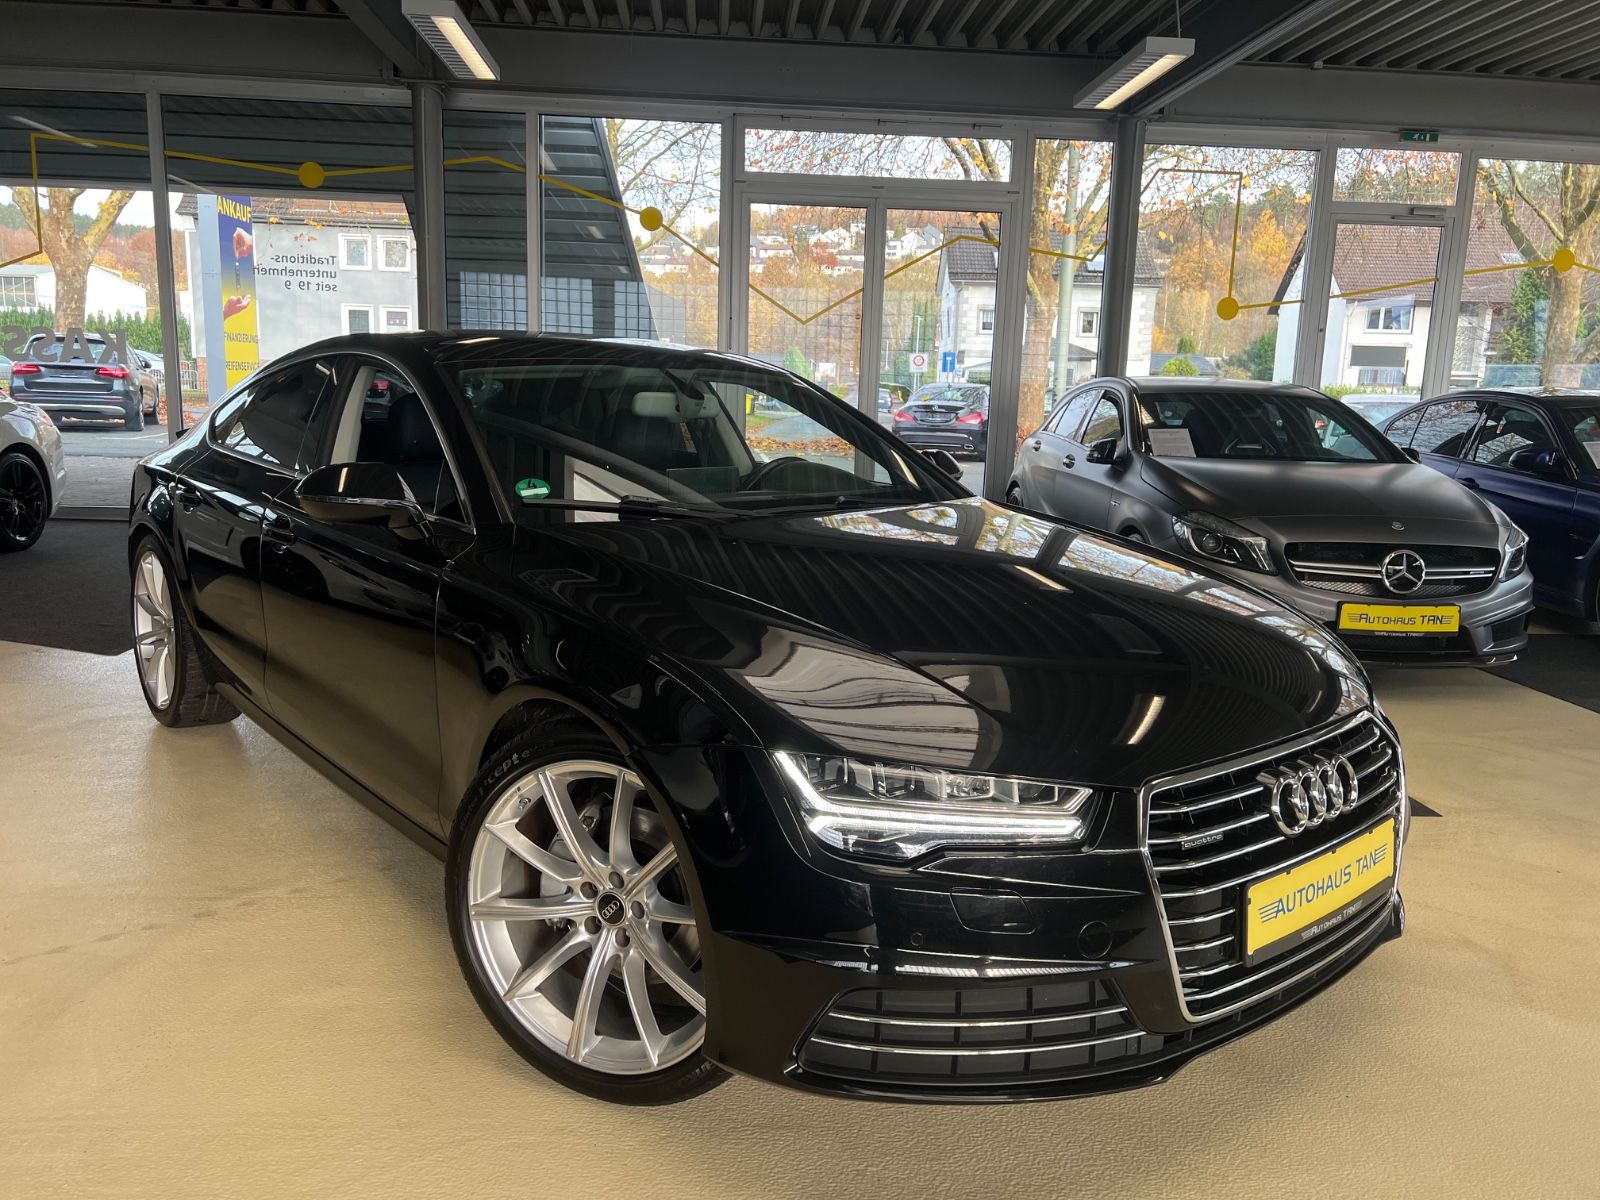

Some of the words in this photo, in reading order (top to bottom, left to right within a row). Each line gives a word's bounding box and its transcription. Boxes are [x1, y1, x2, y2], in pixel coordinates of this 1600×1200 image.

[217, 196, 252, 223] ANKAUF
[1358, 613, 1417, 625] AUTOHAUS
[1420, 615, 1444, 625] TAN
[1184, 833, 1223, 848] quattro
[1275, 864, 1352, 918] AUTOHAUS
[1356, 850, 1378, 877] TAN
